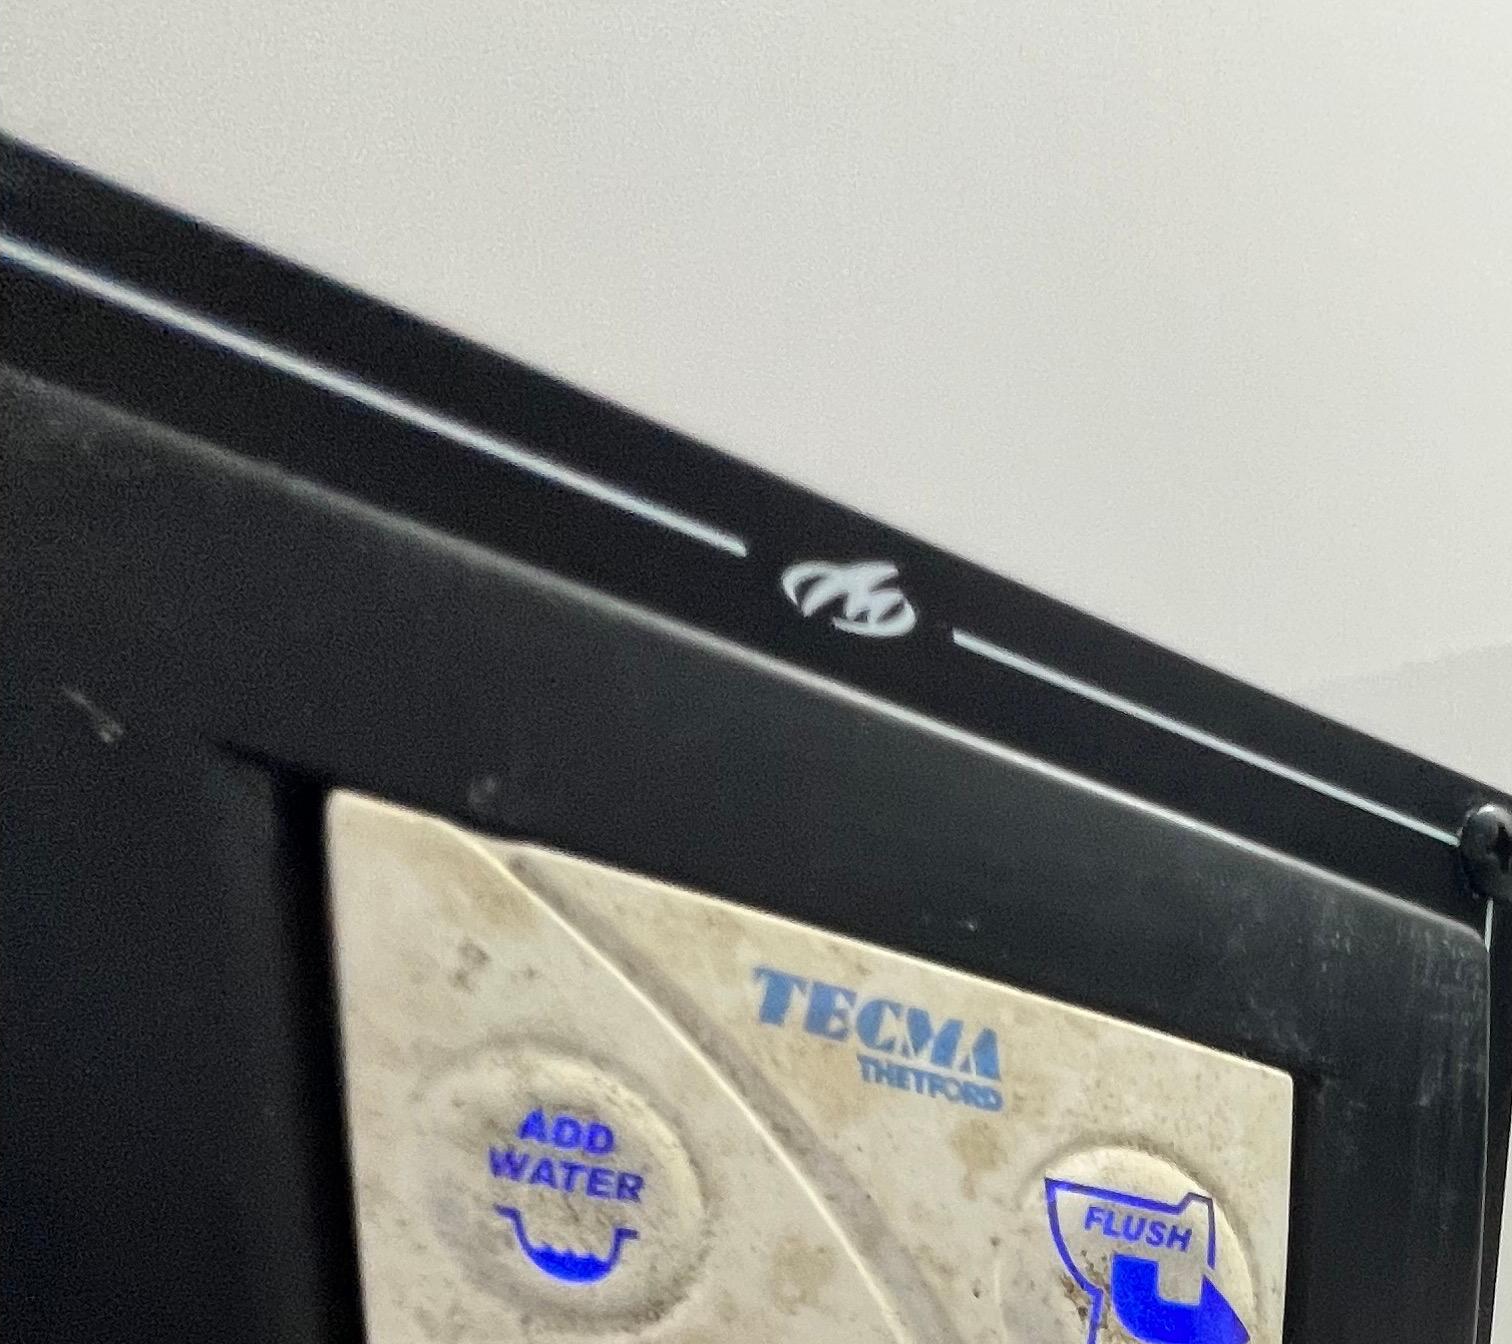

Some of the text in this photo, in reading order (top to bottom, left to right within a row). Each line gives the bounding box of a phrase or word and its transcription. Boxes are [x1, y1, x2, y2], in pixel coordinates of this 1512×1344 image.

[752, 965, 1001, 1081] TECMA
[857, 1054, 1004, 1112] THETFORD
[516, 1106, 615, 1156] ADD
[488, 1143, 645, 1204] WATER
[1084, 1206, 1193, 1252] FLUSH
